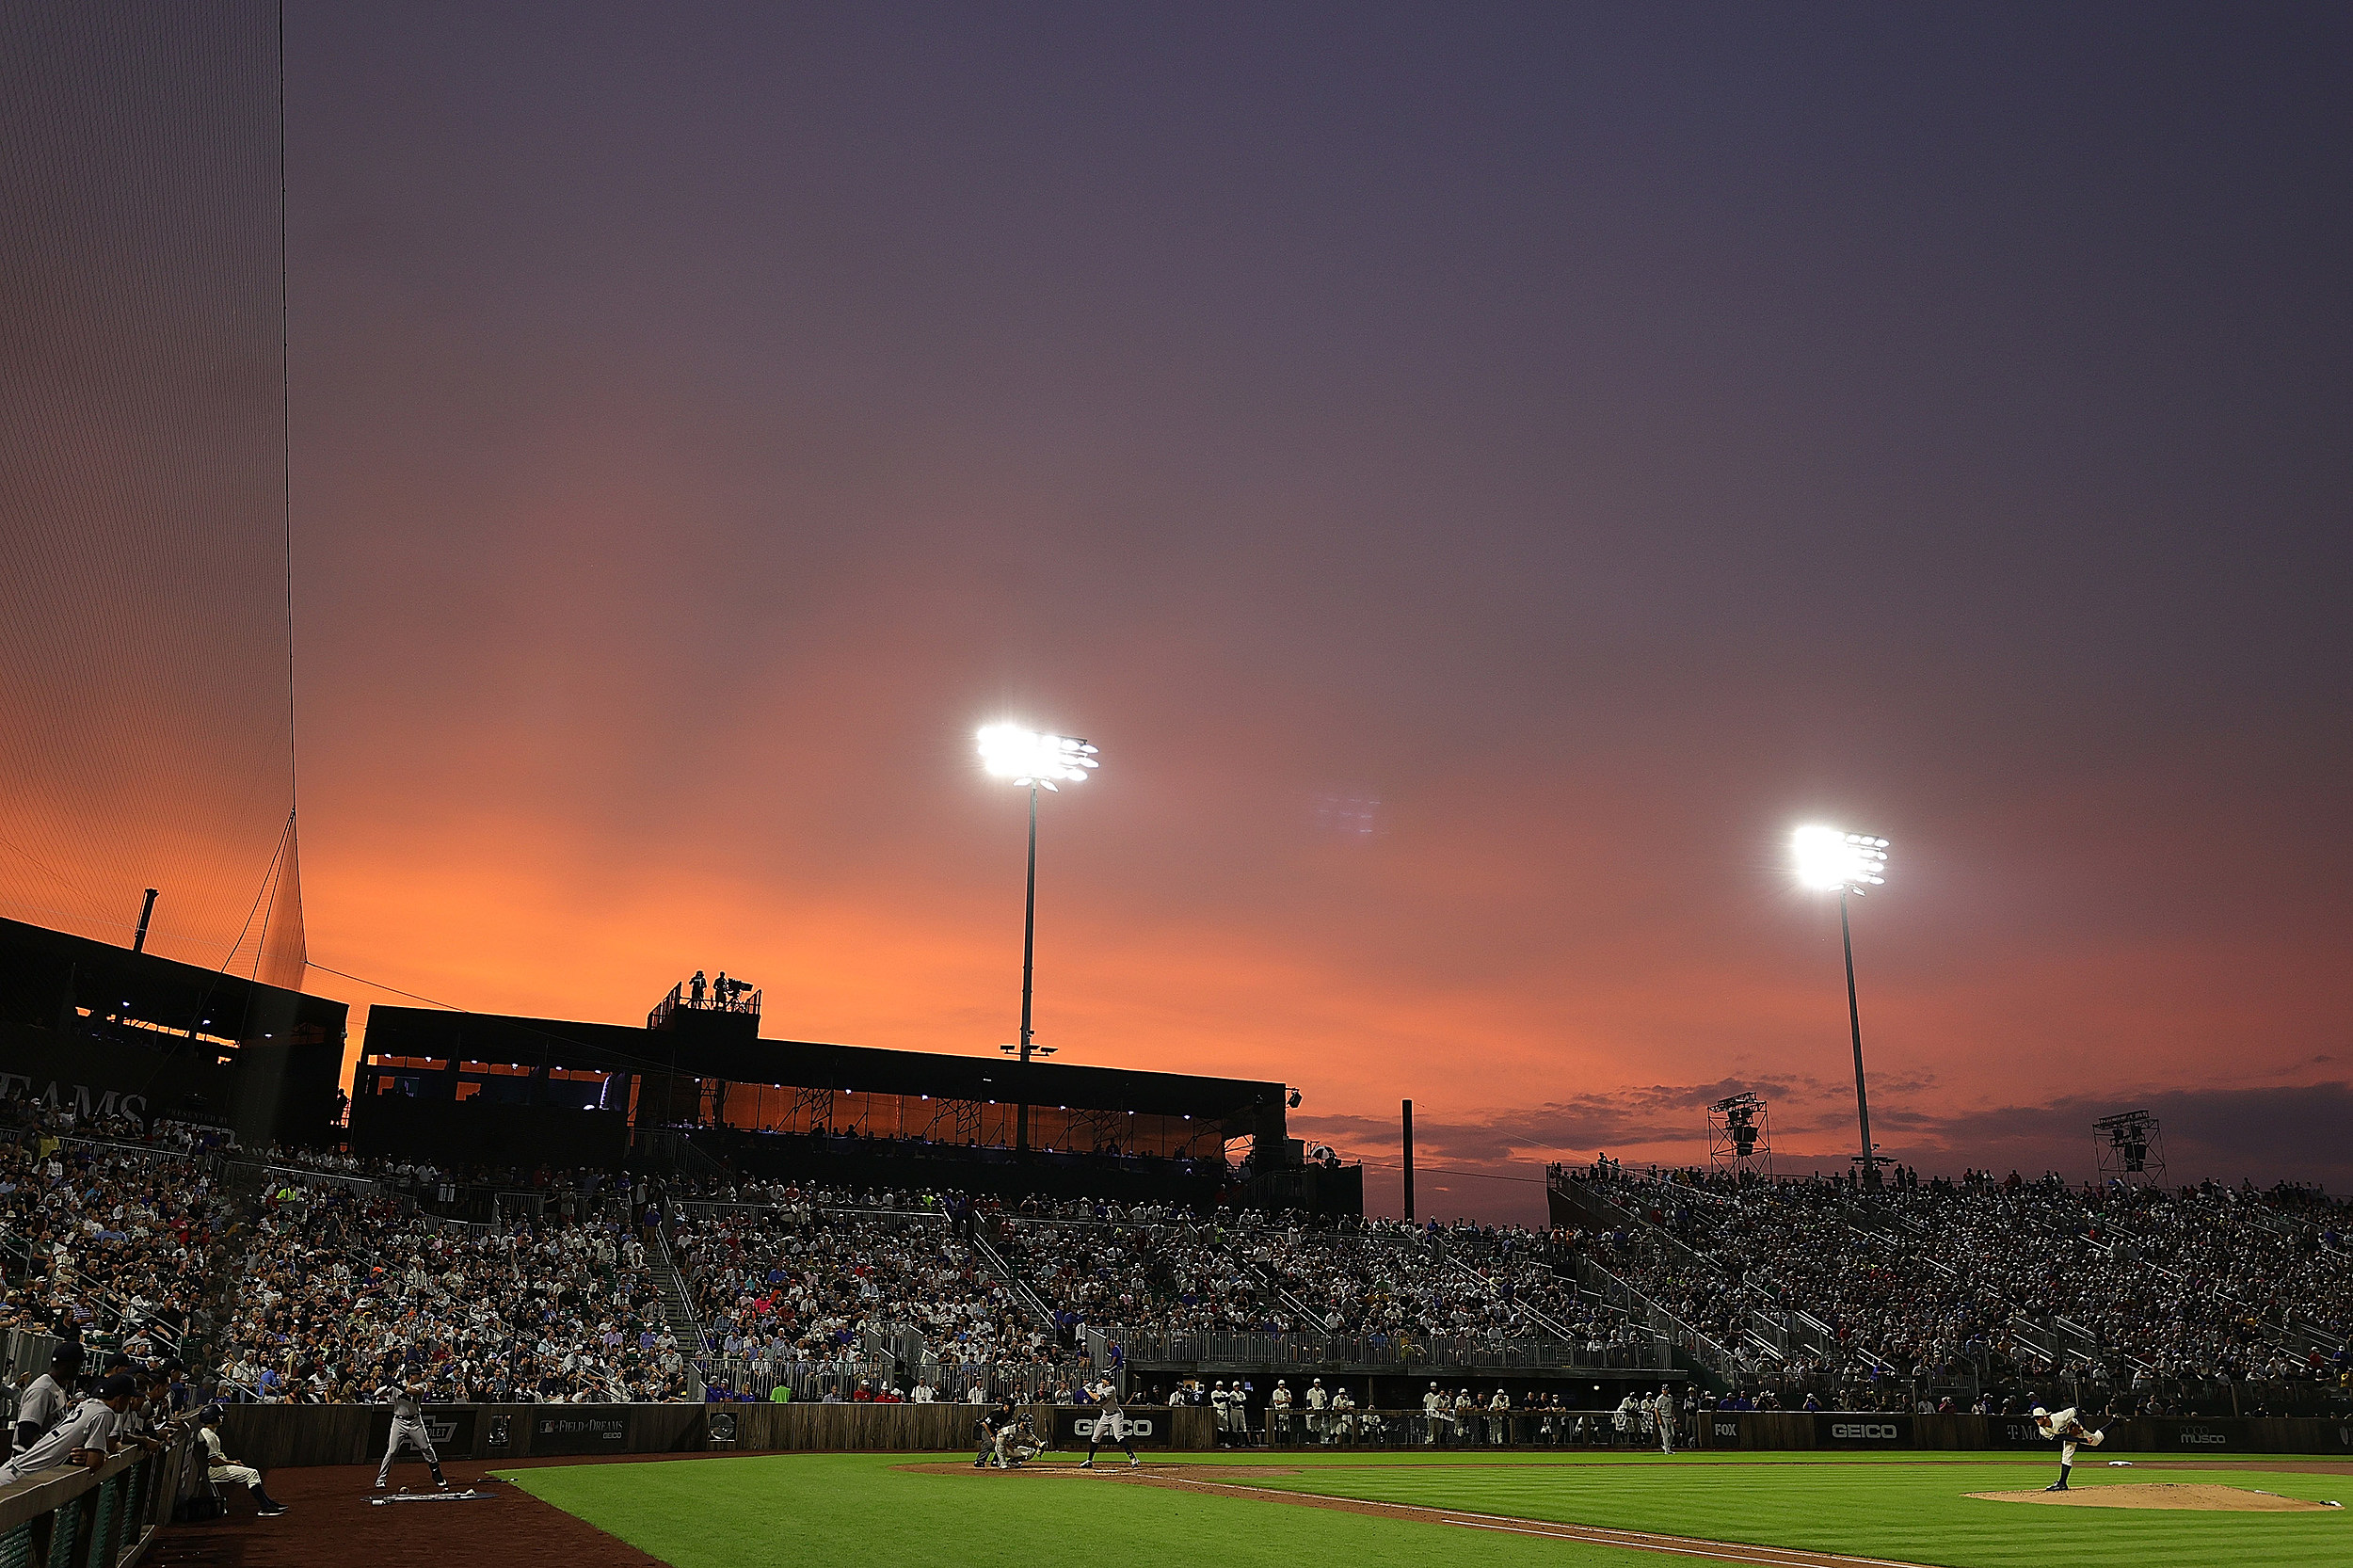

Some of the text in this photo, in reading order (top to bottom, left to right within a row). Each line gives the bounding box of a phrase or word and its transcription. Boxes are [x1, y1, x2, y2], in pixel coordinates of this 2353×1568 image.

[558, 1419, 584, 1432] FIELD
[589, 1418, 623, 1431] DREAMS
[1714, 1423, 1737, 1437] FOX
[1832, 1423, 1898, 1440] GEICO
